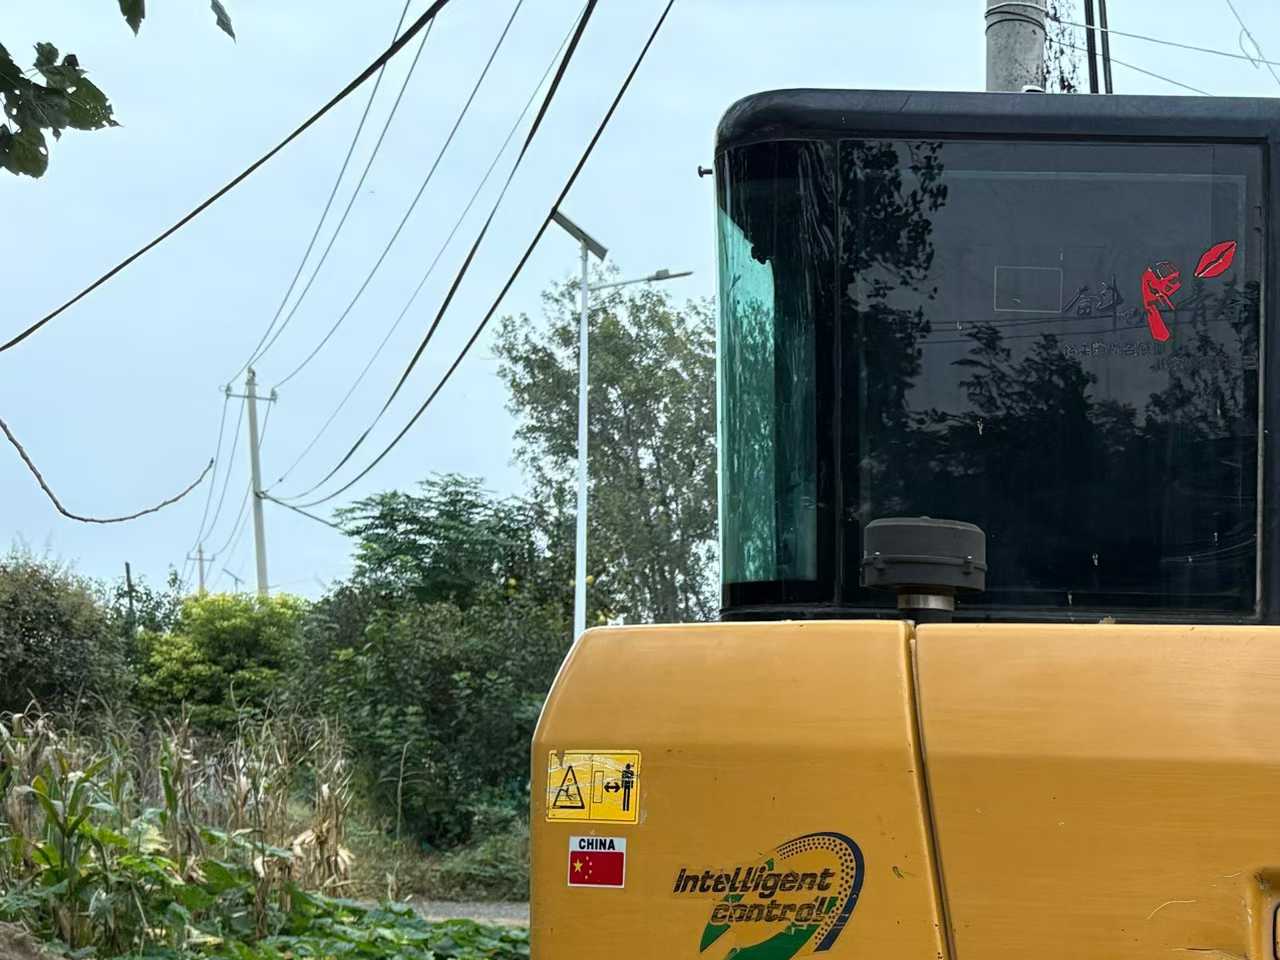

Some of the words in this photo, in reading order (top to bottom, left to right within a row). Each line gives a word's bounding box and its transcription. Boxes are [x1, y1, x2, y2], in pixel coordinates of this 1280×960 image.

[578, 838, 616, 851] CHINA
[673, 865, 835, 899] Intelligent
[710, 897, 827, 923] control
